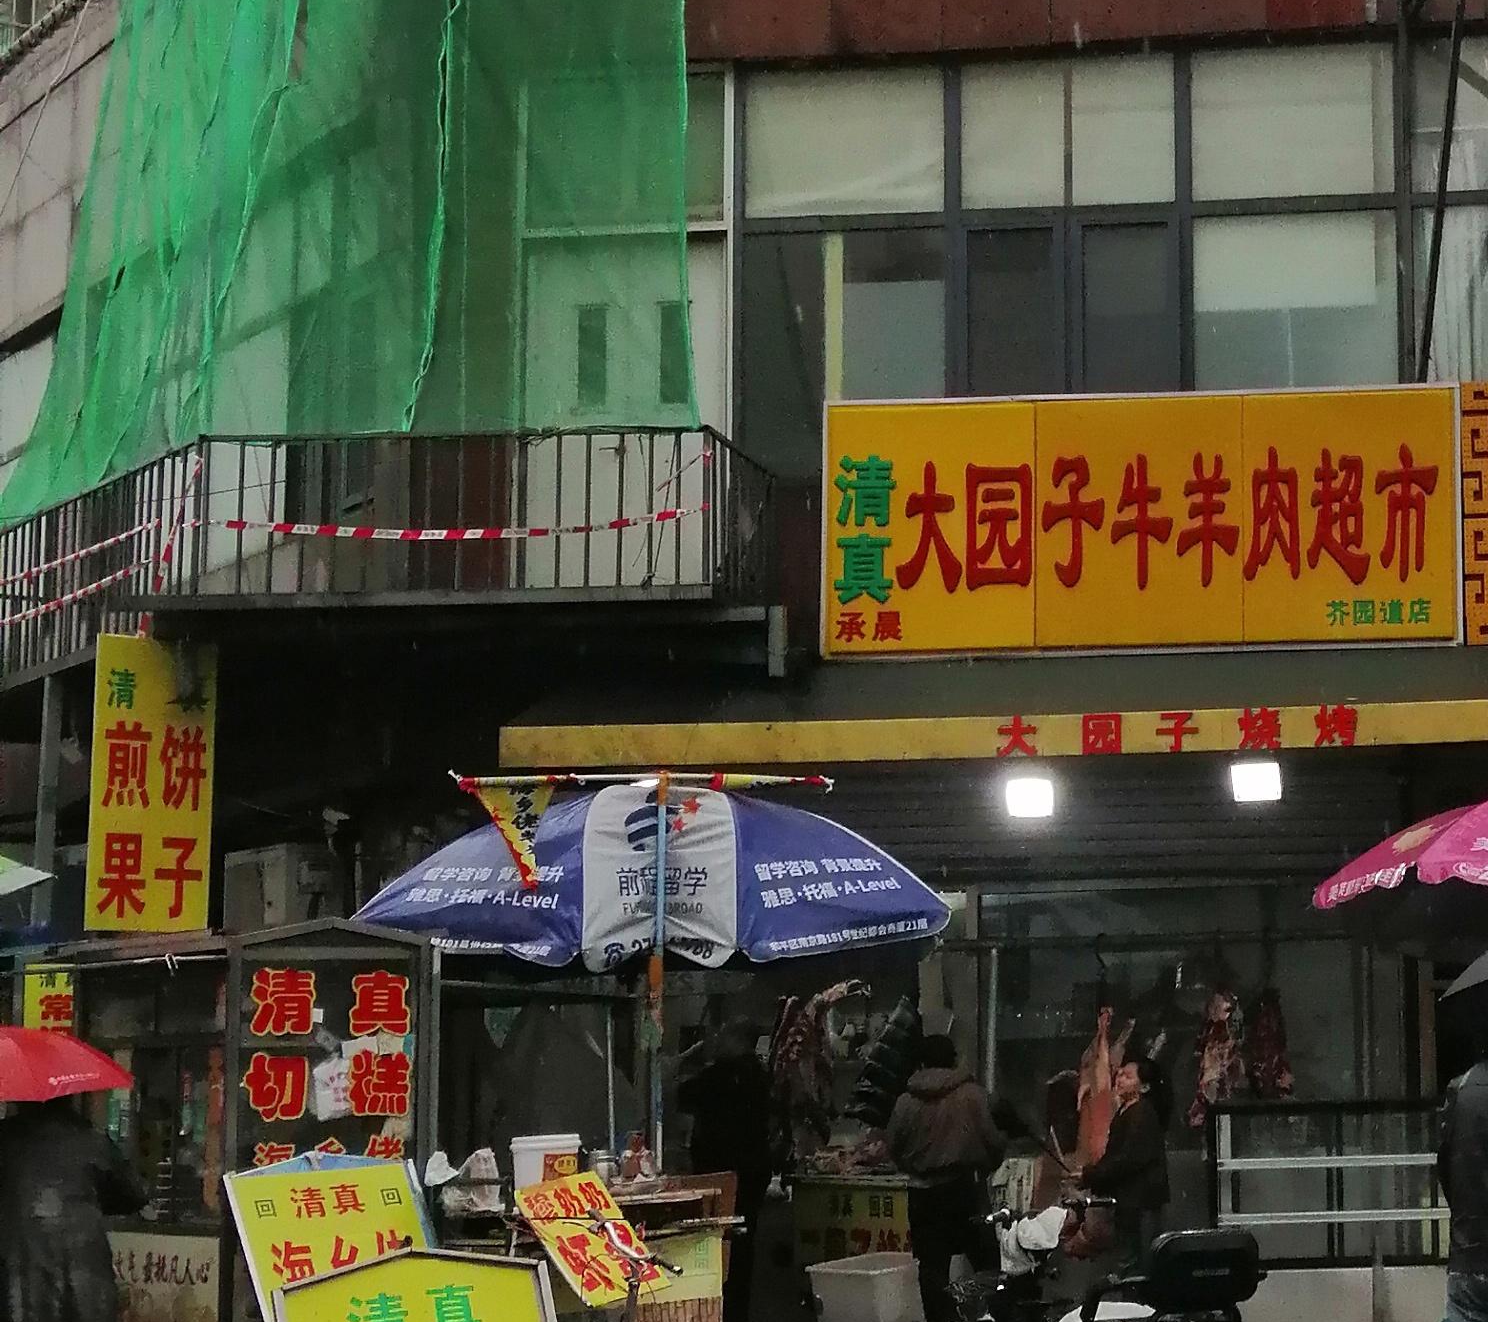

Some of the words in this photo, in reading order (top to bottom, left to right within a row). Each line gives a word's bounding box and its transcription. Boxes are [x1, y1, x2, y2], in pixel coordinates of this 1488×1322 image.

[834, 455, 897, 604] 清真
[896, 443, 1439, 593] 大园子牛羊肉超市
[835, 612, 902, 642] 承晨
[1327, 599, 1431, 626] 芥园道店
[997, 704, 1358, 756] 大园子烧烤
[102, 720, 207, 811] 煎饼
[97, 833, 203, 918] 果子
[422, 867, 493, 882] 留学咨询
[754, 859, 819, 882] 留学咨询
[820, 857, 882, 874] 背景提升
[250, 967, 411, 1037] 清真
[243, 1048, 412, 1122] 切糕
[290, 1183, 366, 1218] 清真
